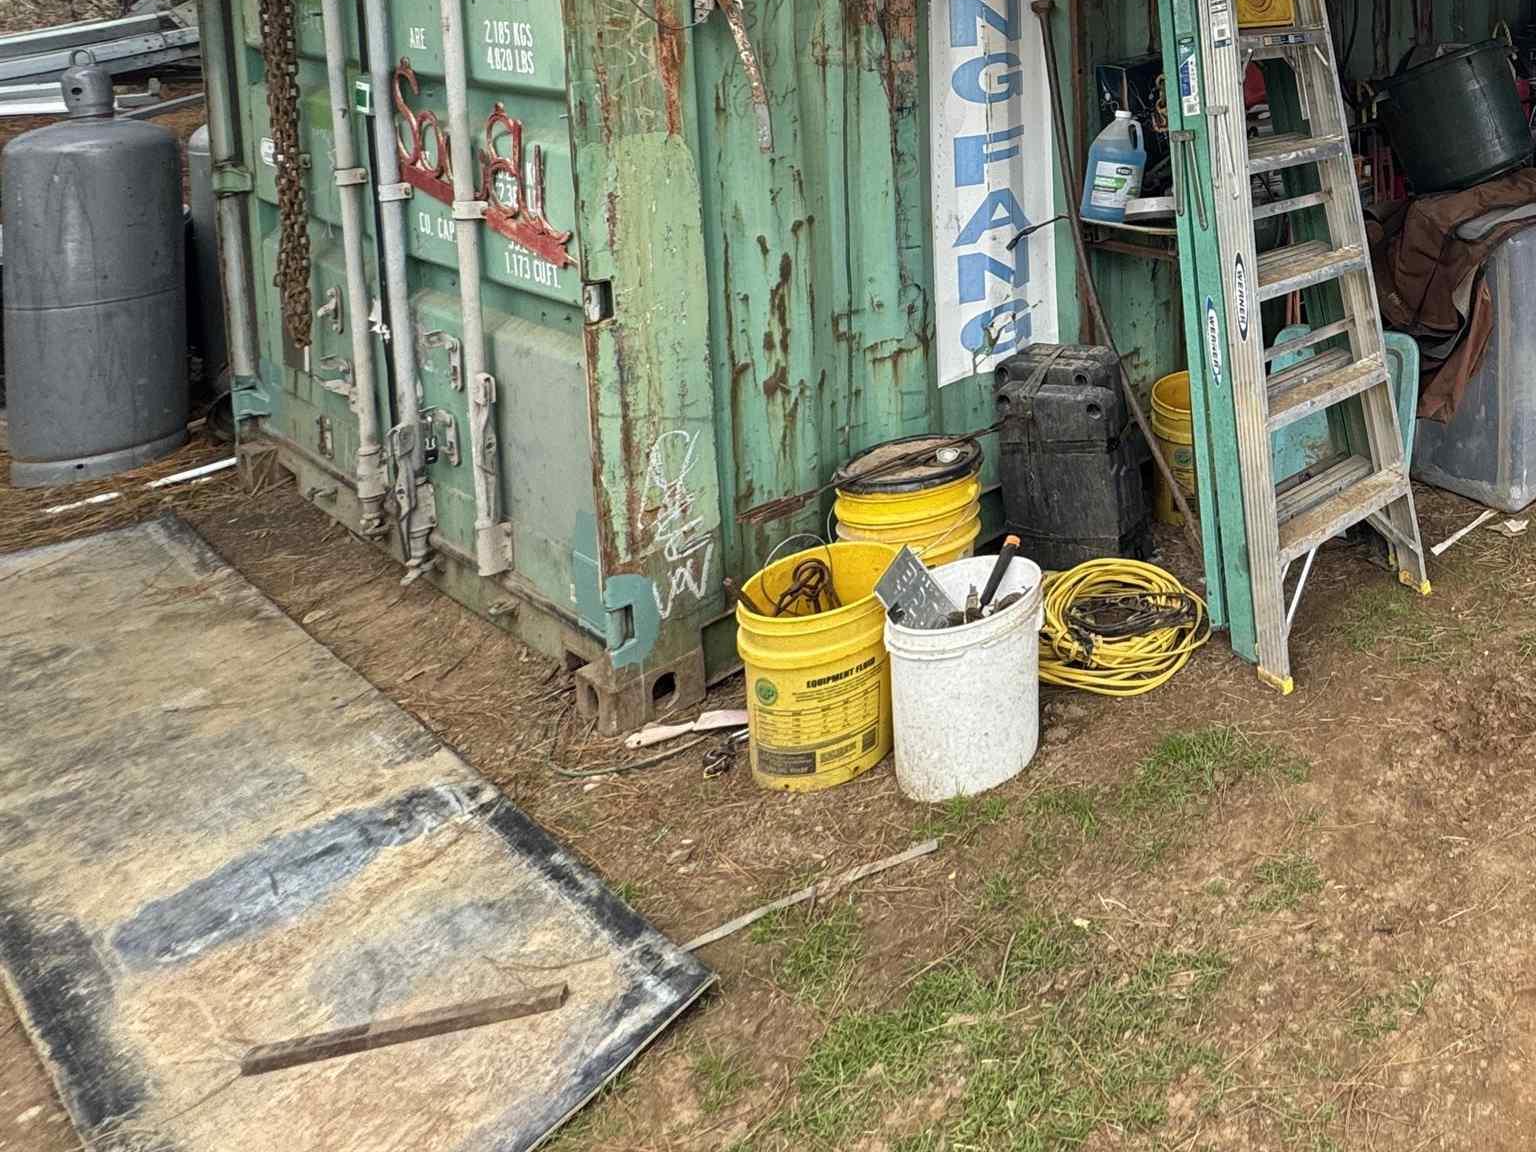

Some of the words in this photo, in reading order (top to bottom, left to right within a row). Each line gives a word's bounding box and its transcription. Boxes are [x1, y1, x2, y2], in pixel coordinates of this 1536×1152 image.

[512, 22, 533, 48] KGS
[514, 48, 535, 74] LBS
[1237, 270, 1246, 324] WERNER
[1209, 315, 1219, 368] WERNER
[806, 667, 855, 689] EQUIPMENT
